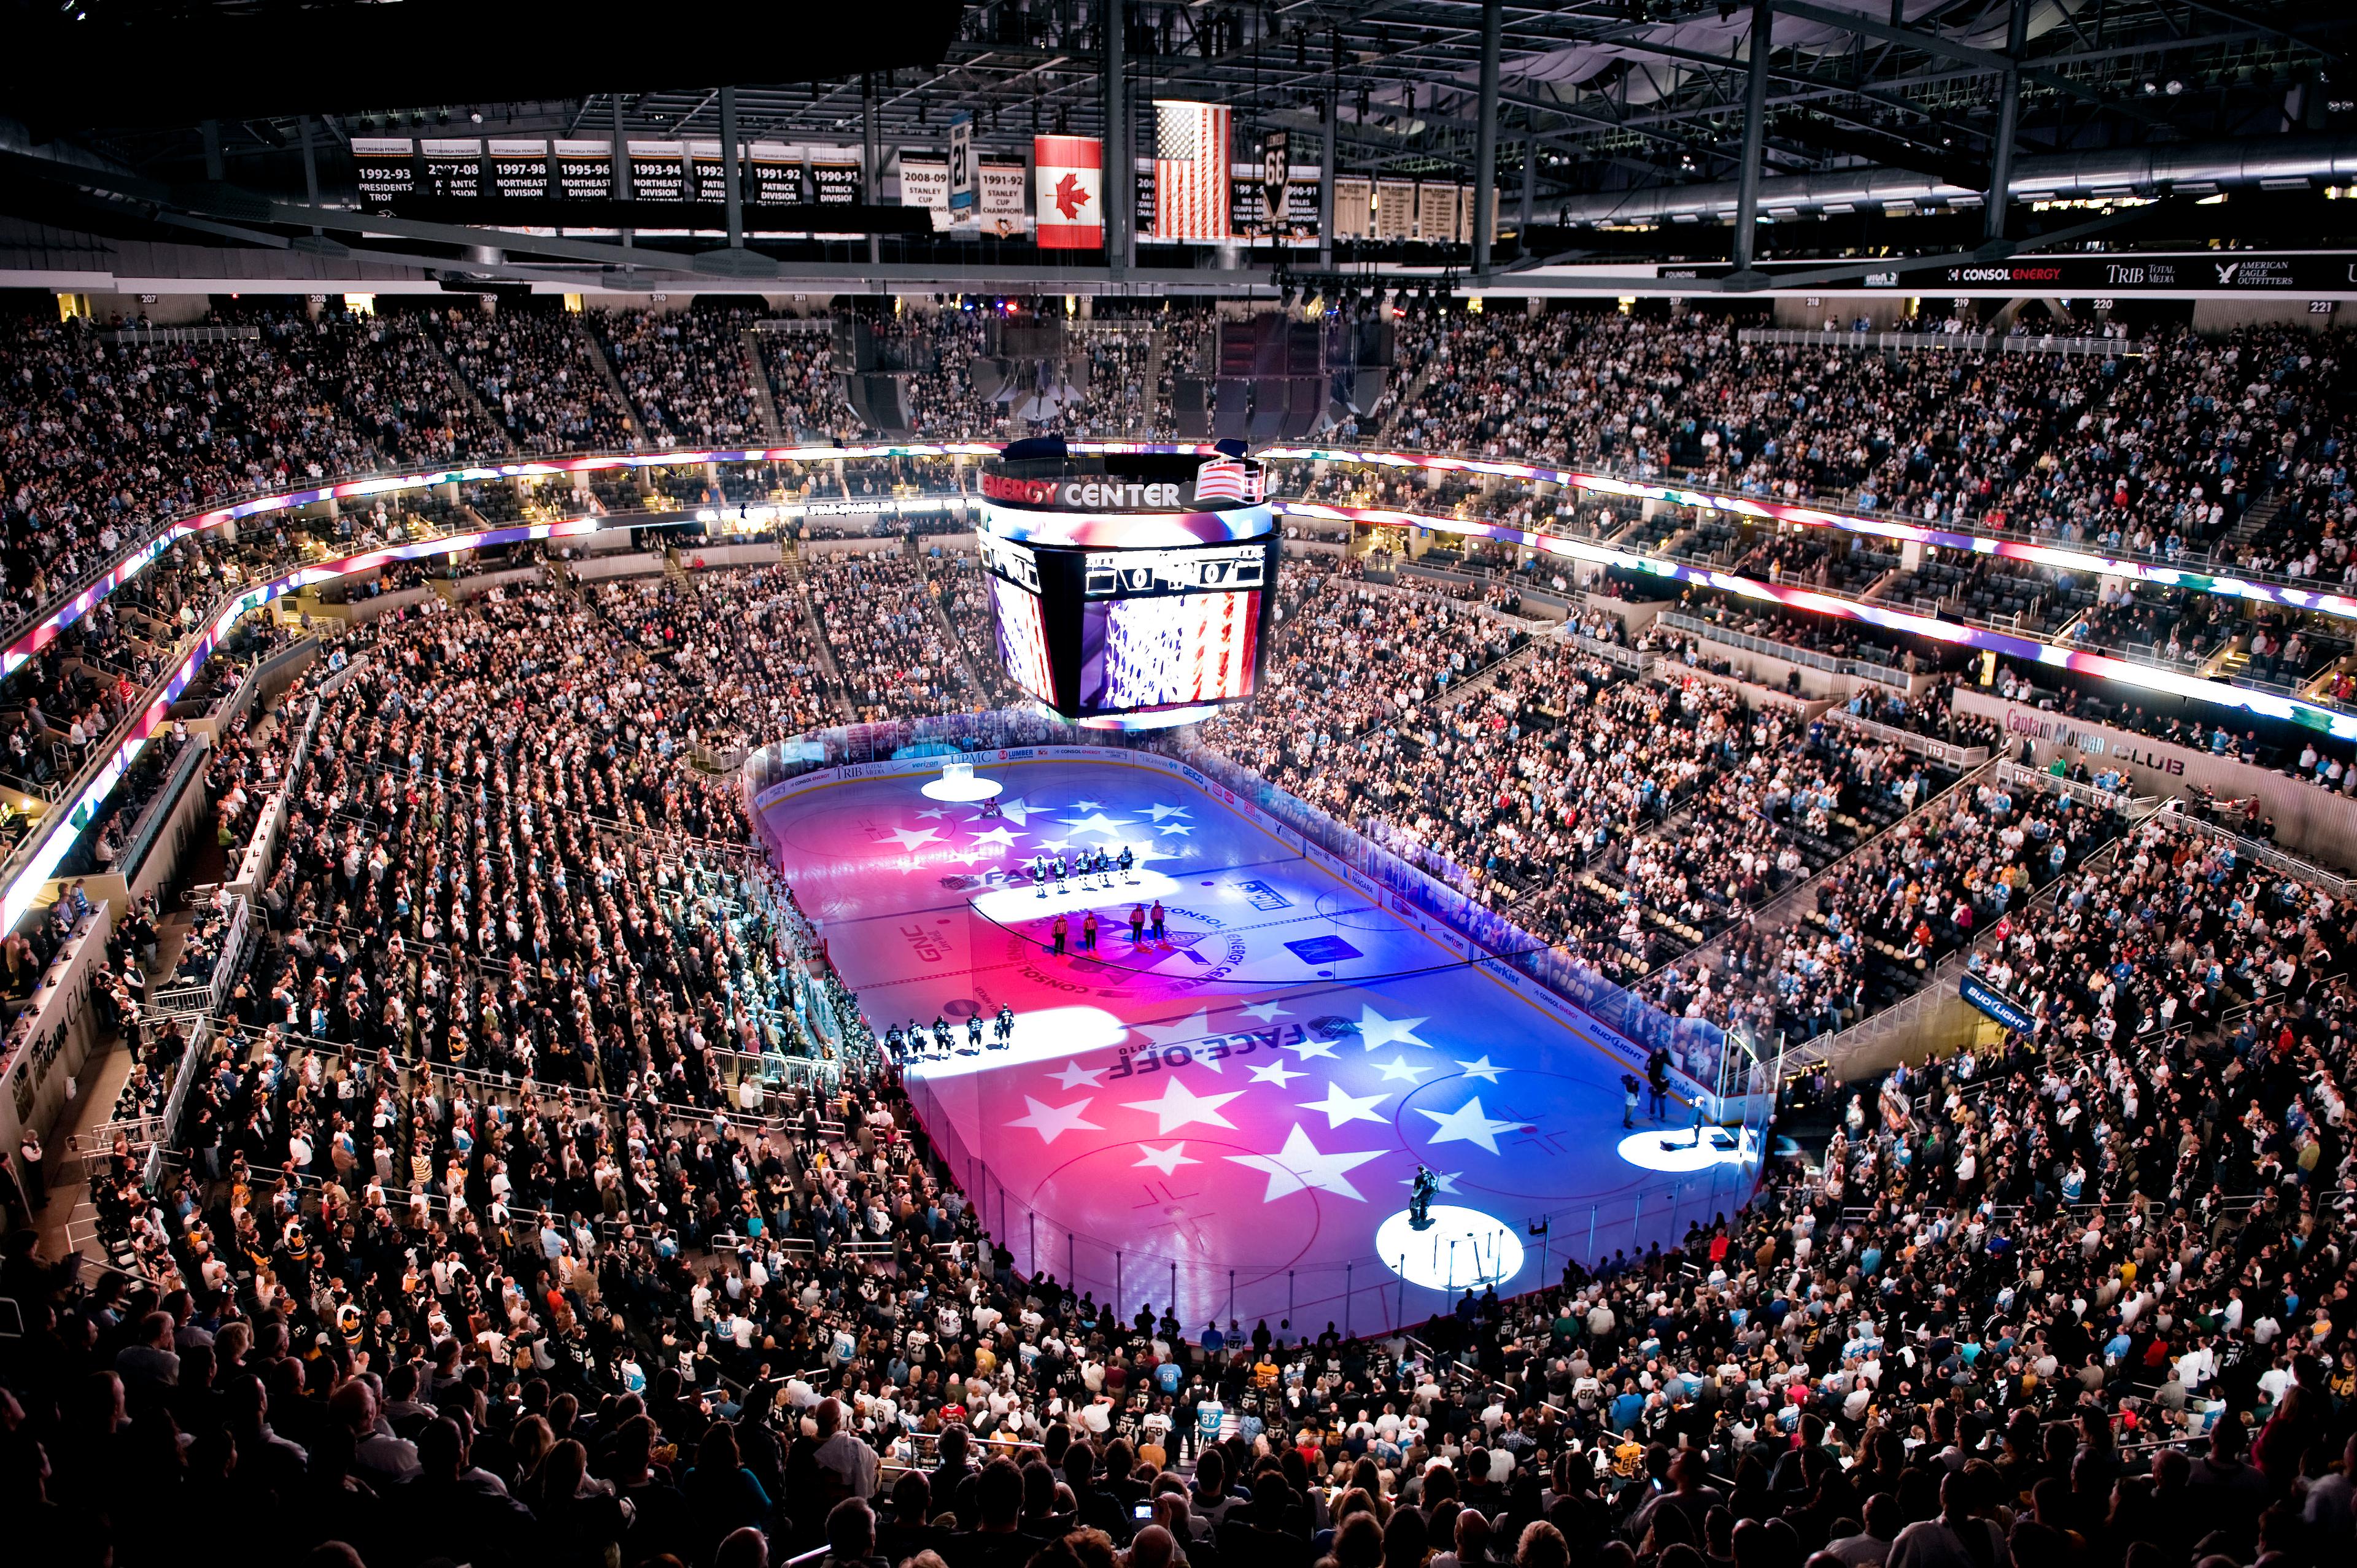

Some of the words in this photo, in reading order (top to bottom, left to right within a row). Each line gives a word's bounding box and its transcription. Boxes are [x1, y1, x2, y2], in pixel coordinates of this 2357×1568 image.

[497, 164, 546, 174] 1997-98
[562, 164, 610, 175] 1995-96
[633, 164, 681, 175] 1993-94
[954, 144, 966, 187] 21
[1265, 151, 1285, 186] 66
[359, 169, 411, 179] 1992-93
[756, 168, 800, 179] 1991-92
[814, 171, 857, 182] 1990-91
[905, 172, 946, 182] 2008-09
[359, 181, 414, 191] PRESIDENTS'
[984, 176, 1023, 185] 1991-92
[1289, 185, 1317, 195] 990-91
[1962, 269, 2011, 280] CONSOL
[2012, 269, 2061, 280] ENERGY
[2106, 265, 2144, 284] TRIB
[2149, 264, 2175, 274] TOTAL
[2148, 274, 2175, 284] MEDIA
[142, 295, 156, 303] 207
[1954, 298, 1969, 307] 219
[2093, 299, 2113, 309] 220
[2310, 302, 2332, 312] 221
[983, 475, 1059, 504] ENERGY
[1065, 483, 1180, 507] CENTER
[1132, 568, 1147, 589] 0
[1205, 563, 1219, 584] 0
[1518, 621, 1527, 630] 110
[1655, 660, 1666, 671] 112
[2007, 708, 2052, 741] Captain
[2052, 722, 2105, 755] Morgan
[2111, 743, 2185, 776] CLUB
[1008, 749, 1034, 758] LUMBER
[1929, 744, 1943, 757] 113
[950, 751, 991, 764] UPMC
[834, 767, 862, 779] TRIB
[1183, 766, 1204, 784] GEICO
[2014, 770, 2032, 784] 114
[794, 778, 811, 786] CONSOL
[1352, 875, 1373, 894] NIAGARA
[1163, 906, 1228, 929] CONSOL
[1227, 933, 1246, 966] ENERGY
[1443, 931, 1464, 951] verizon
[900, 924, 942, 962] GNC
[1482, 957, 1520, 986] StarKist
[1016, 966, 1089, 994] CONSOL
[1539, 991, 1559, 1010] CONSOL
[1559, 1005, 1578, 1021] ENERGY
[1967, 985, 1995, 1008] BUD
[1993, 1000, 2028, 1030] LIGHT
[1119, 1041, 1157, 1055] 2010
[1590, 1024, 1611, 1041] BUD
[1612, 1038, 1644, 1061] LIGHT
[1109, 1023, 1307, 1080] FACE-OFF
[894, 1149, 904, 1159] 71
[940, 1315, 951, 1327] 44
[1957, 1320, 1970, 1332] 71
[721, 1324, 730, 1333] 71
[1501, 1324, 1512, 1335] 87
[818, 1331, 829, 1343] 87
[909, 1343, 924, 1354] 27
[1229, 1340, 1242, 1350] 87
[1020, 1355, 1032, 1365] 87
[1163, 1373, 1174, 1382] 58
[1580, 1389, 1595, 1400] 87
[1137, 1398, 1148, 1409] 17
[1241, 1399, 1257, 1409] 87
[774, 1409, 784, 1422] 71
[878, 1410, 884, 1423] 8
[1202, 1414, 1218, 1424] 87
[1120, 1422, 1136, 1434] 87
[1268, 1429, 1283, 1439] 87
[1622, 1458, 1638, 1470] 66
